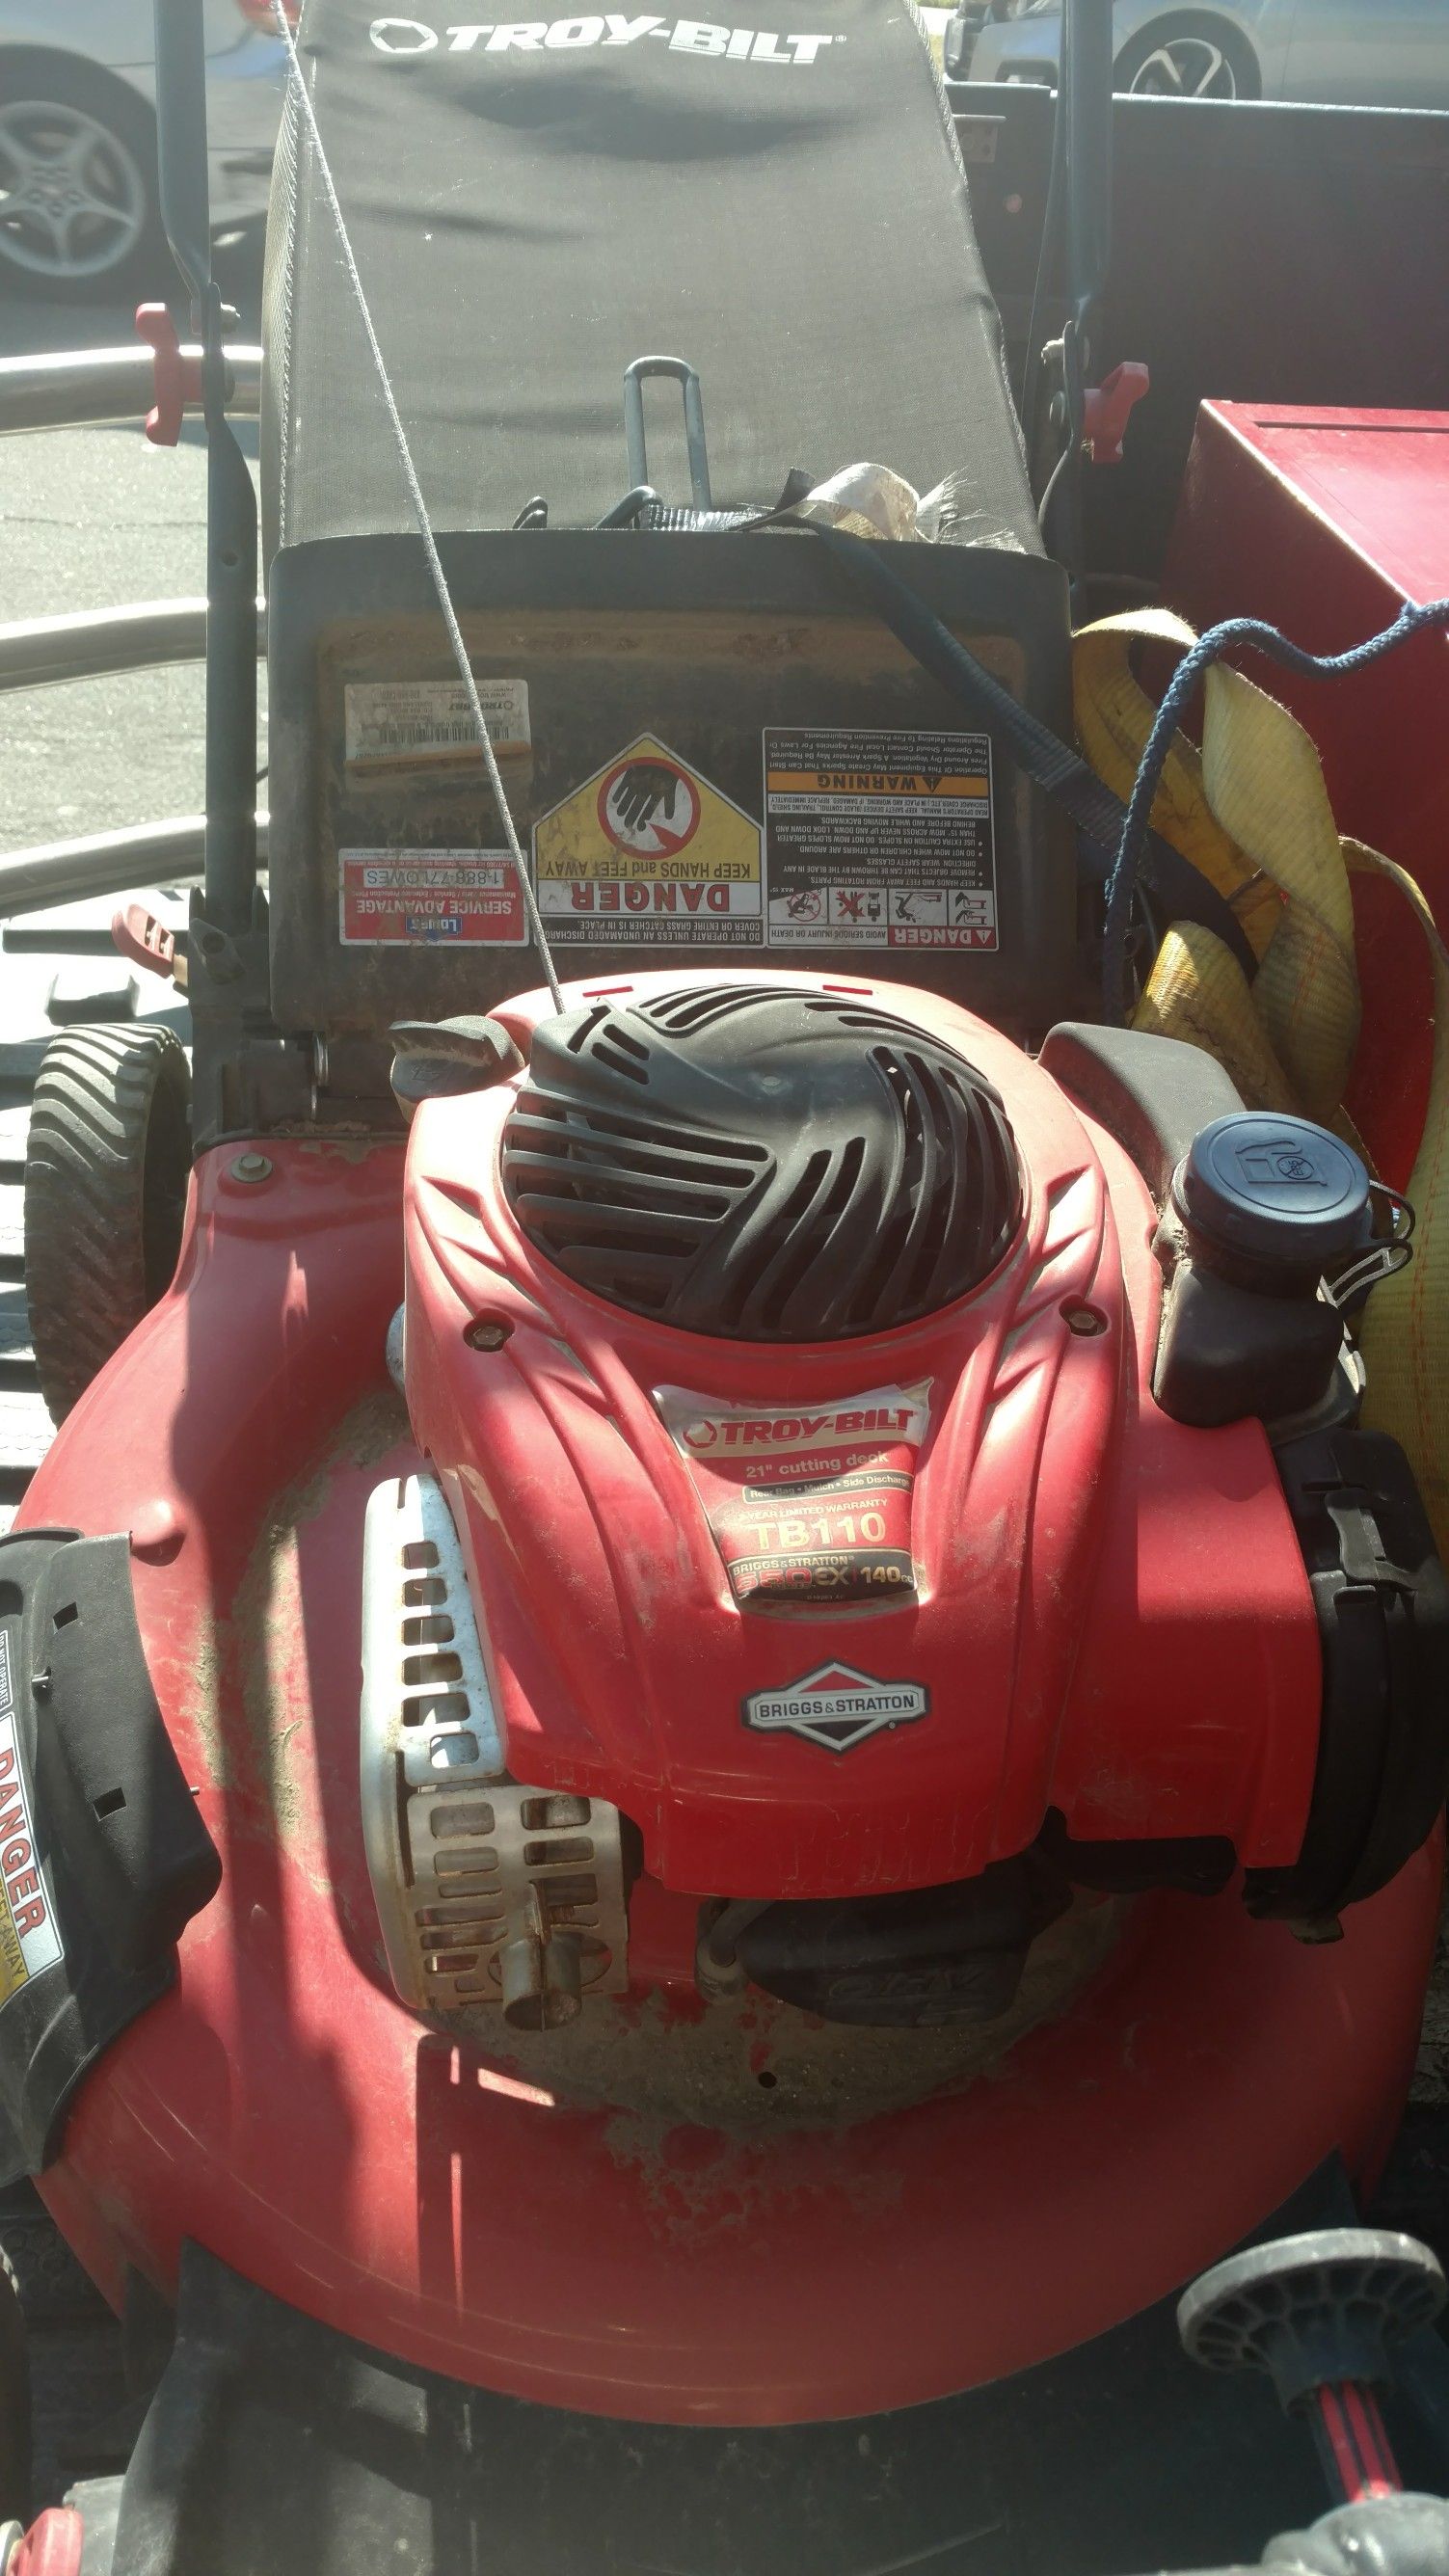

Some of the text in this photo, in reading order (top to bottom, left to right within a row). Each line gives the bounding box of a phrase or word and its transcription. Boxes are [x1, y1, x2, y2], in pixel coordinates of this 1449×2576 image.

[445, 14, 833, 64] TROY-BILT
[918, 735, 945, 743] Relating
[948, 736, 987, 744] Regulations
[822, 762, 845, 770] Sparks
[890, 764, 926, 772] Equipment
[954, 765, 987, 774] Operation
[818, 775, 917, 791] WARNING
[546, 861, 750, 878] KEEP HANDS and FEET AWAY
[571, 882, 730, 912] DANGER
[357, 899, 512, 915] SERVICE ADVANTAGE
[630, 922, 664, 930] CATCHER
[667, 922, 690, 930] GRASS
[694, 922, 719, 930] ENTIRE
[721, 922, 732, 930] OR
[735, 922, 760, 931] COVER
[588, 931, 640, 940] UNDAMAGED
[644, 931, 655, 940] AN
[657, 931, 688, 940] UNLESS
[692, 932, 728, 941] OPERATE
[732, 932, 746, 941] NOT
[749, 932, 760, 941] DO
[895, 928, 972, 944] DANGER
[721, 1409, 914, 1444] TROY-BILT
[746, 1450, 888, 1478] 21" cutting deck
[804, 1482, 835, 1492] Mulch
[843, 1478, 865, 1489] Side
[780, 1499, 888, 1516] LIMITED WARRANTY
[746, 1512, 886, 1550] TB110
